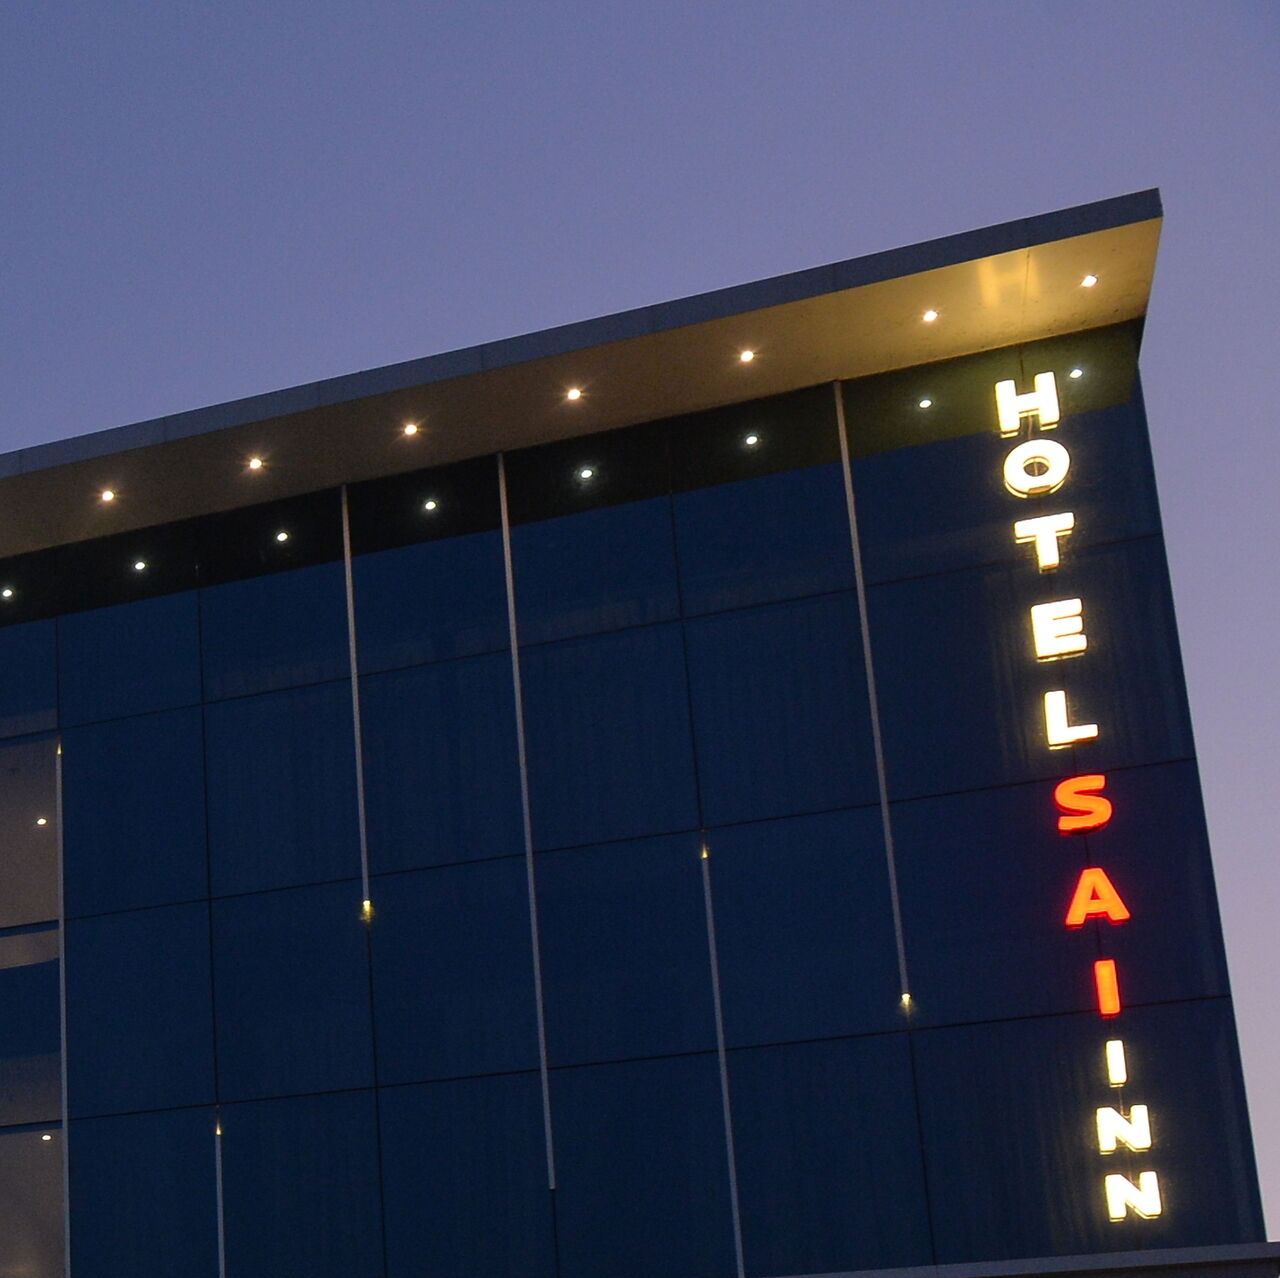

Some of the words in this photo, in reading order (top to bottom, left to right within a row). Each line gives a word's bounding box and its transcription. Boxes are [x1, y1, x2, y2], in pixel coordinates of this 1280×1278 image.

[994, 371, 1100, 750] HOTEL
[1054, 774, 1132, 1018] SAI
[1095, 1039, 1163, 1223] INN
